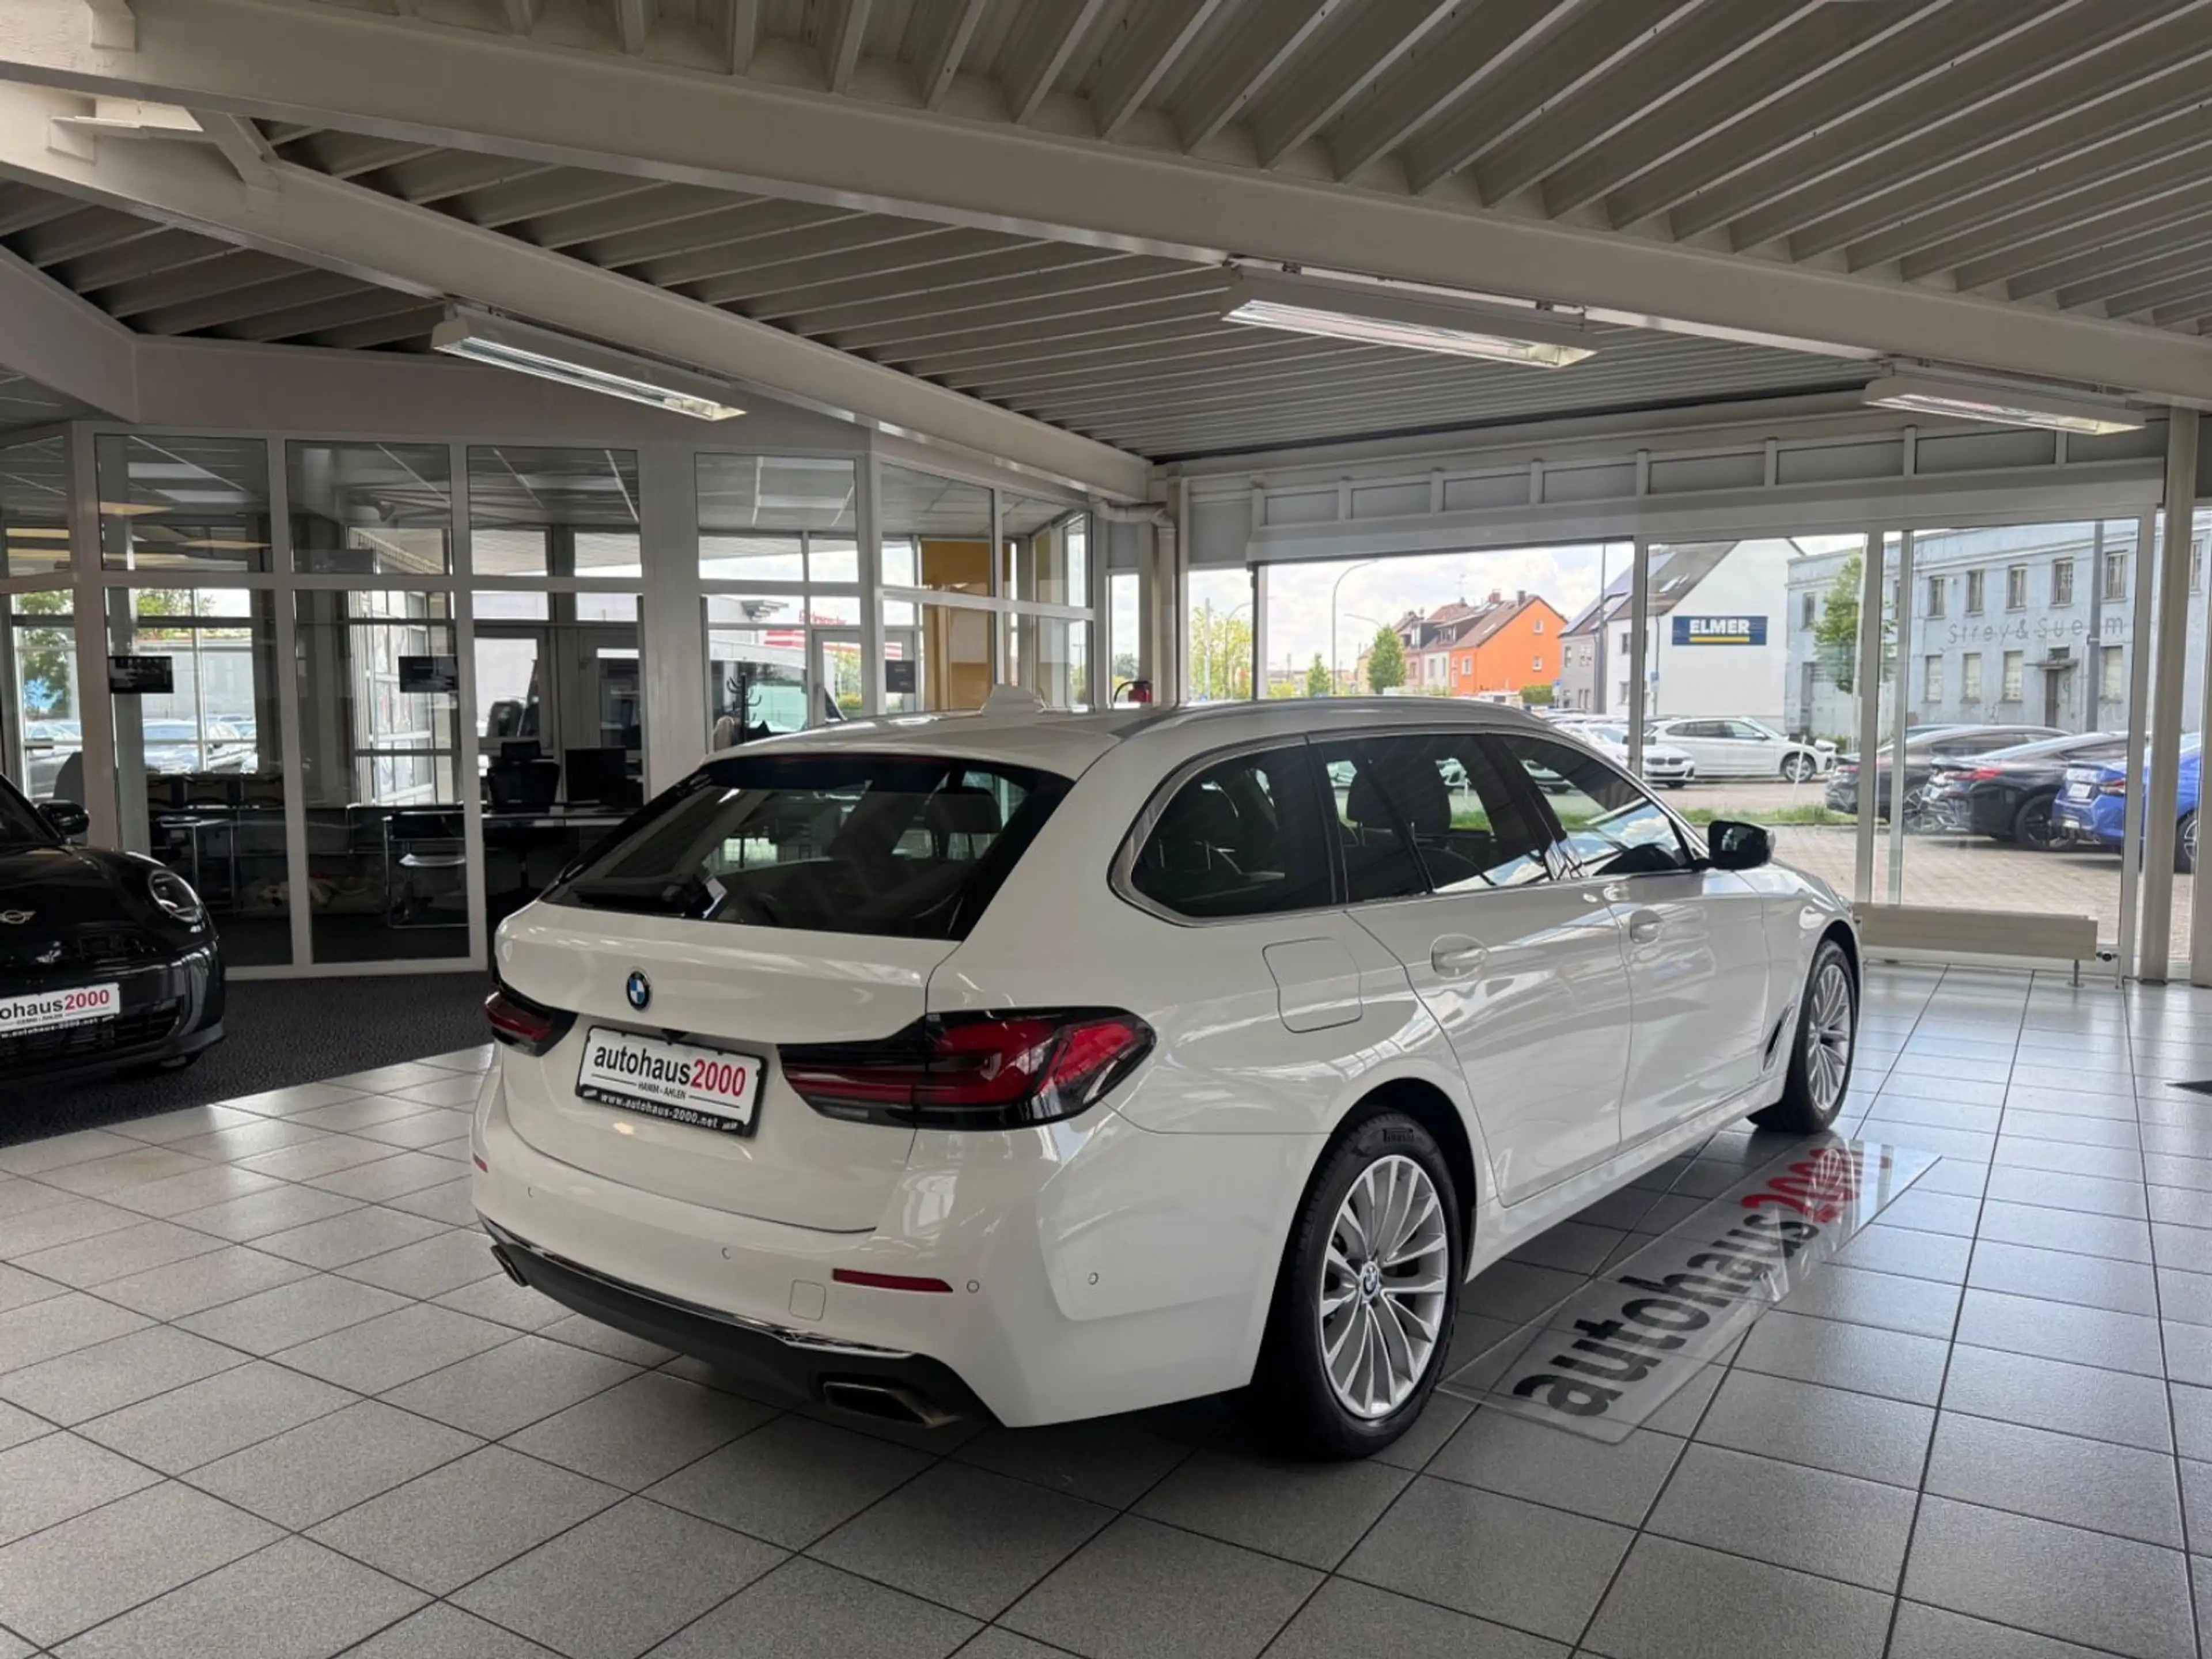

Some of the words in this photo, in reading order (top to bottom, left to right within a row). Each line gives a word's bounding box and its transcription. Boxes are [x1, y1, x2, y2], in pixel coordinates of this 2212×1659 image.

[1690, 619, 1750, 634] ELMER
[594, 1046, 746, 1097] autohaus2000
[601, 1094, 718, 1128] www.autohaus-2000.net
